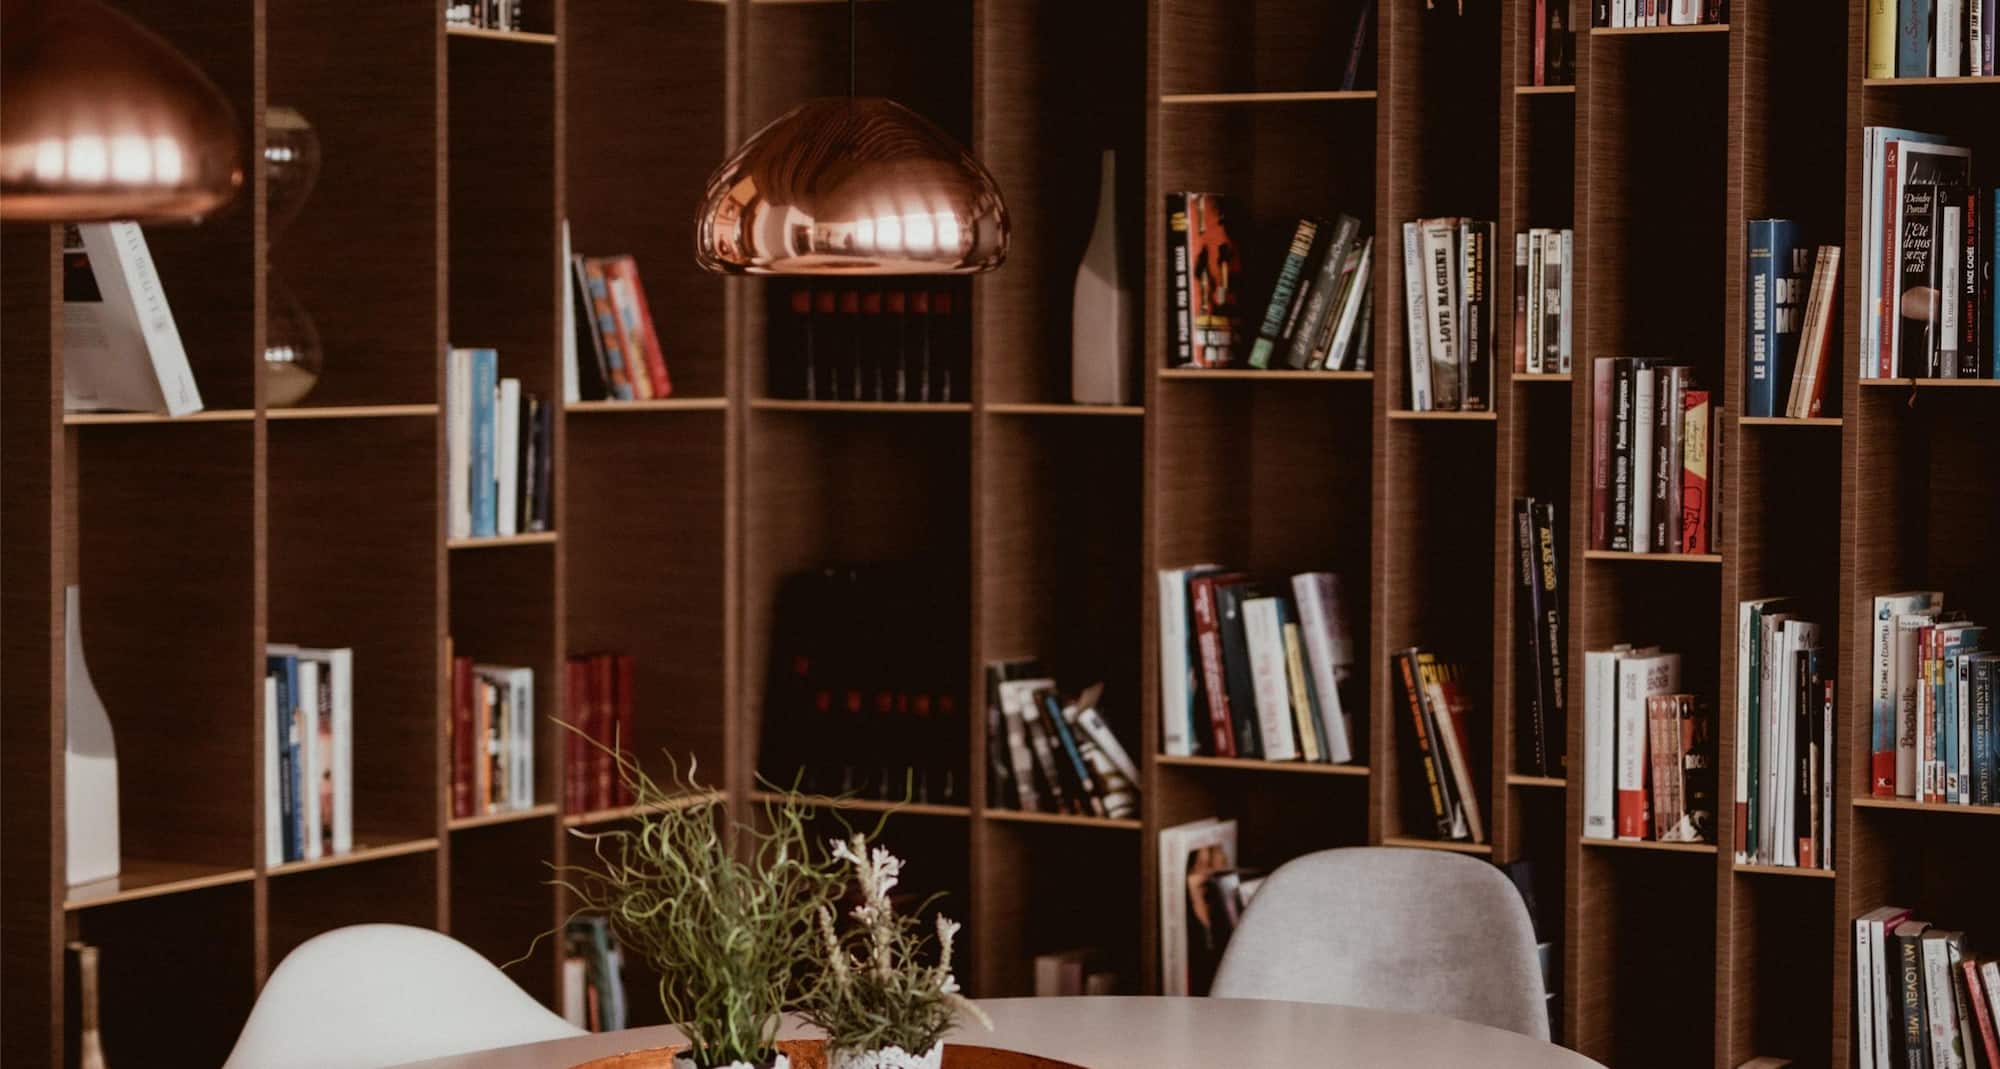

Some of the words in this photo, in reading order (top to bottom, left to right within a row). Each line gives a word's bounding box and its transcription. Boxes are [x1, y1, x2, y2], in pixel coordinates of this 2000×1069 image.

[1435, 248, 1449, 307] MACHINE
[1753, 273, 1767, 331] MONDIAL
[1439, 311, 1452, 344] LOVE
[1753, 334, 1767, 362] DEFI
[1753, 365, 1767, 380] LE
[1540, 527, 1553, 563] ATLAS
[1543, 563, 1556, 592] 2000
[1547, 609, 1558, 624] La
[1549, 623, 1559, 656] France
[1976, 686, 1985, 721] SANDRA
[1976, 724, 1985, 760] BROWN
[1980, 760, 1989, 801] TAILSPIN
[1903, 944, 1916, 965] MY
[1905, 967, 1918, 1009] LOVELY
[1908, 1014, 1921, 1043] WIFE
